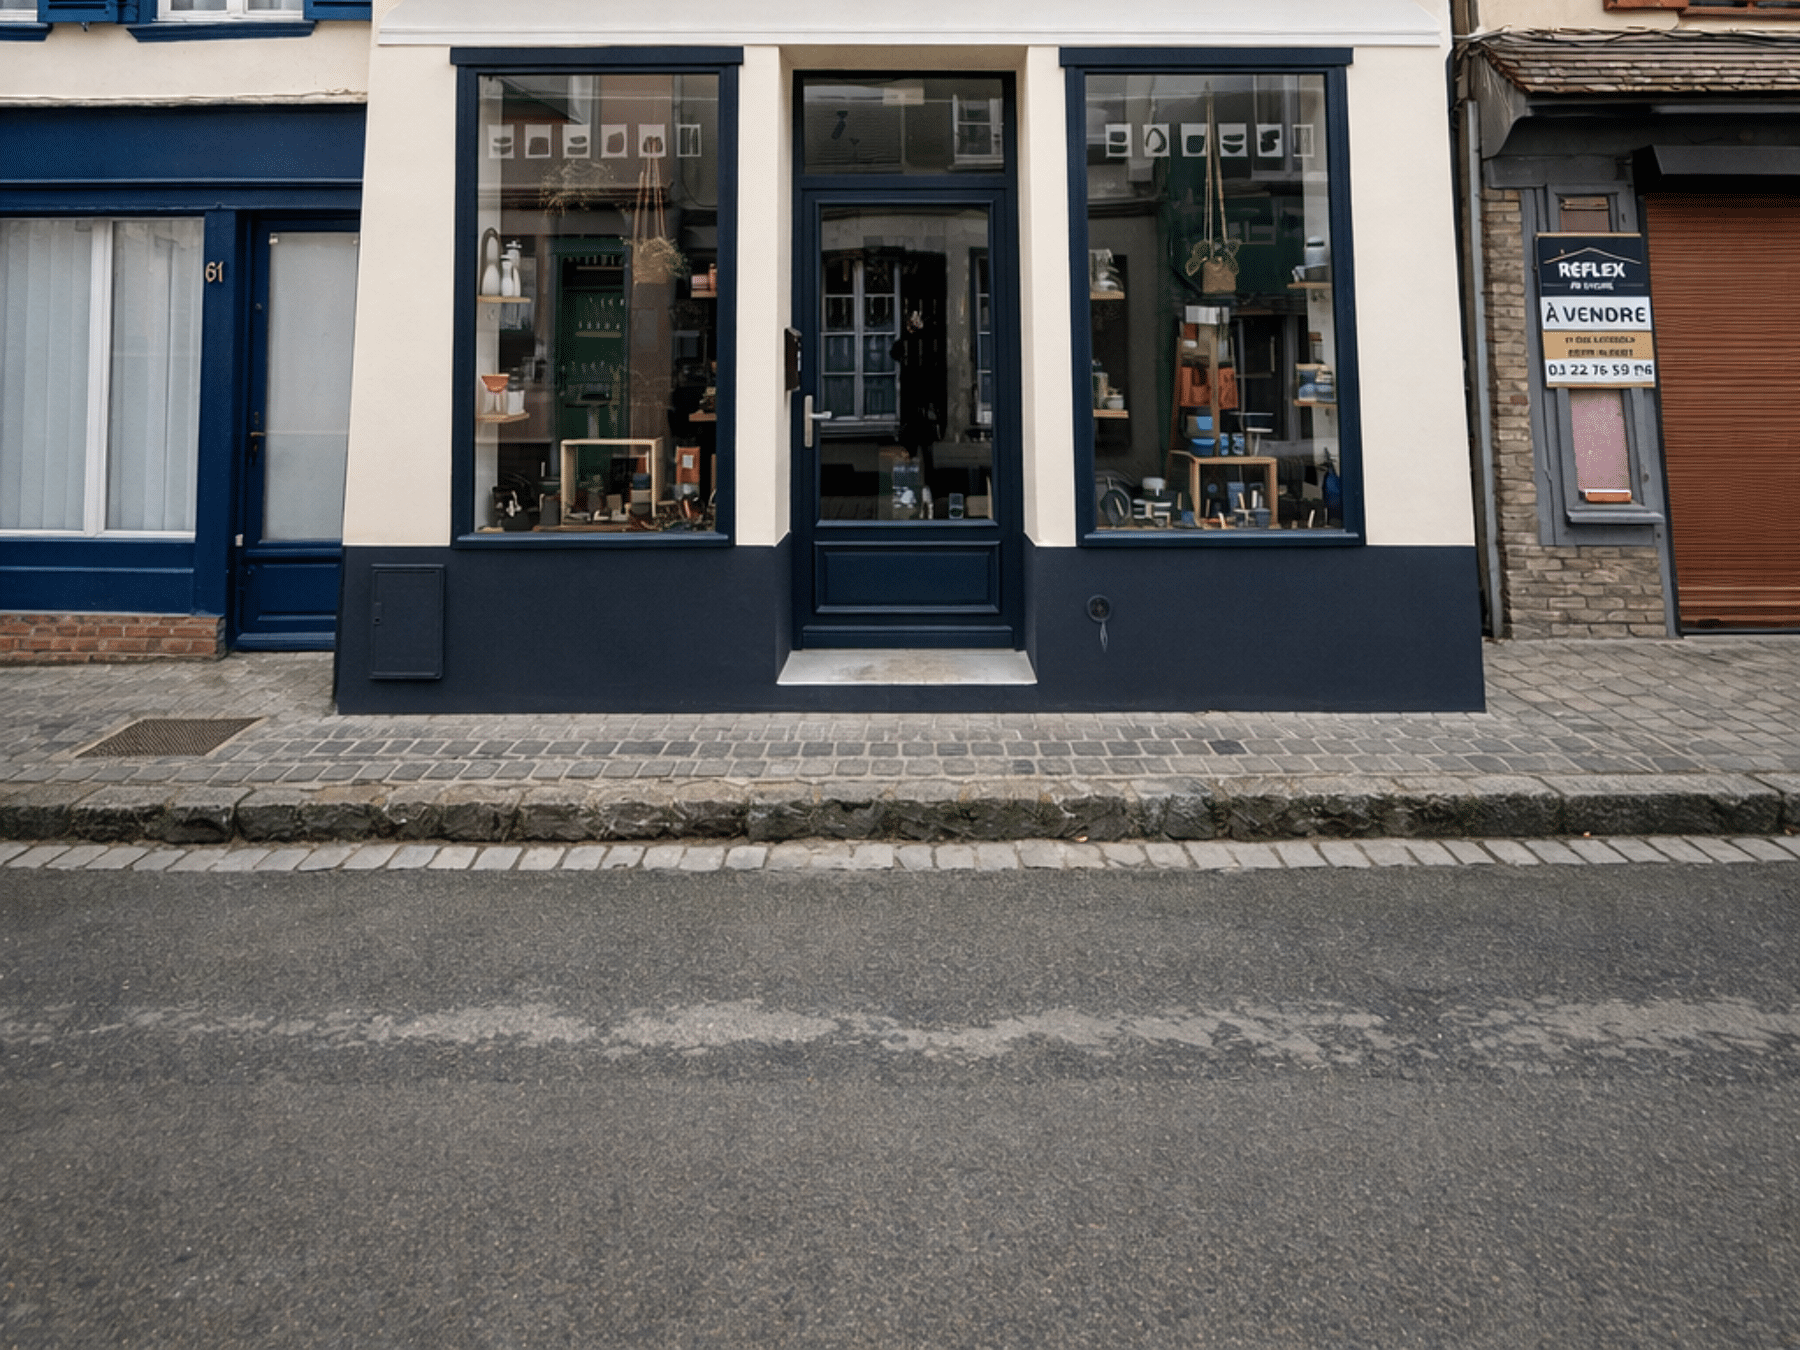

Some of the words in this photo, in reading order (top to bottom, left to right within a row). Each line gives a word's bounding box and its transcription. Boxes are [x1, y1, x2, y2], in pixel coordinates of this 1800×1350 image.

[205, 261, 224, 283] 61
[1558, 261, 1626, 278] REFLEX
[1546, 302, 1560, 323] À
[1562, 306, 1646, 323] VENDRE
[1570, 364, 1588, 375] 22
